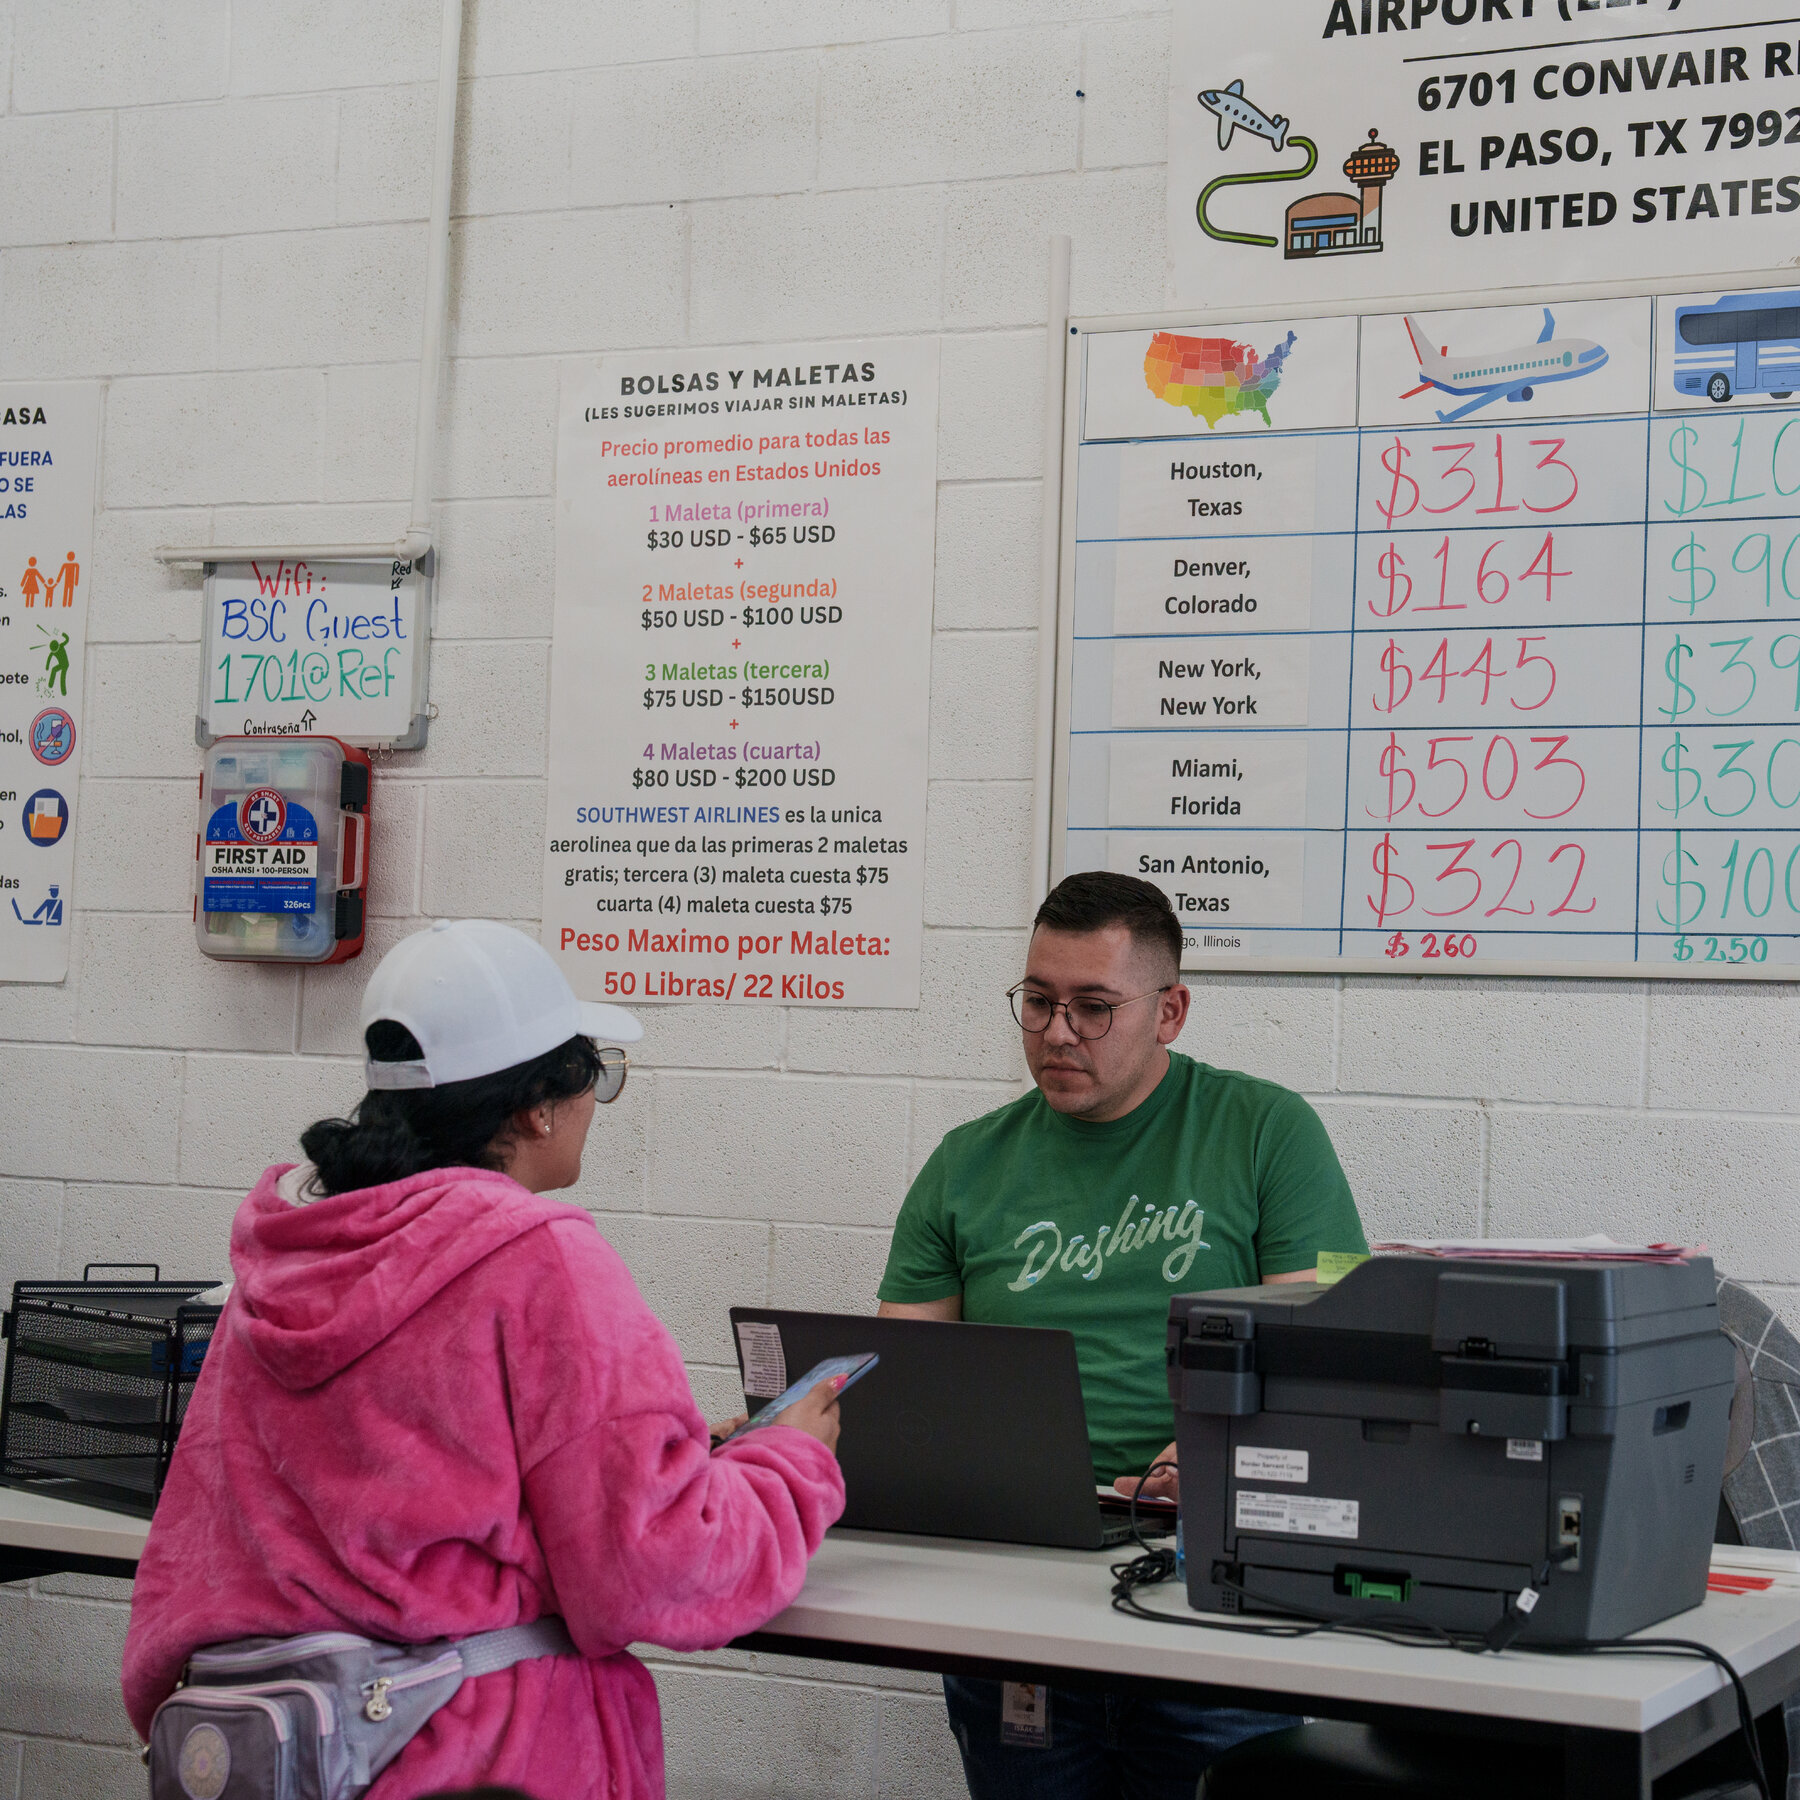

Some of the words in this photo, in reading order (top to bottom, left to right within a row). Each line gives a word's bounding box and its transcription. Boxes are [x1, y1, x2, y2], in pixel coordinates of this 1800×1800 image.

[1418, 69, 1515, 111] 6701
[1533, 47, 1749, 100] CONVAIR
[1765, 40, 1800, 78] R
[1419, 140, 1464, 176] EL
[1481, 127, 1612, 171] PASO,
[1628, 118, 1687, 157] TX
[1451, 192, 1617, 237] UNITED
[1633, 176, 1800, 223] STATES
[621, 372, 719, 395] BOLSAS
[728, 370, 744, 389] Y
[753, 362, 875, 388] MALETAS
[0, 407, 47, 425] ASA
[585, 407, 618, 422] (LES
[624, 402, 719, 418] SUGERIMOS
[725, 398, 783, 412] VIAJAR
[789, 396, 815, 409] SIN
[822, 390, 907, 407] MALETAS)
[602, 439, 658, 457] Precio
[664, 434, 753, 459] promedio
[759, 436, 800, 454] para
[805, 429, 858, 447] todas
[865, 427, 890, 444] las
[608, 468, 702, 487] aerolíneas
[708, 470, 729, 482] en
[736, 462, 808, 481] Estados
[815, 459, 880, 477] Unidos
[1171, 462, 1262, 480] Houston,
[1375, 434, 1579, 529] $313
[14, 477, 34, 492] SE
[650, 506, 659, 522] 1
[666, 503, 731, 521] Maleta
[738, 498, 828, 523] (primera)
[1188, 499, 1242, 516] Texas
[647, 529, 683, 551] $30
[691, 529, 731, 547] USD
[750, 525, 786, 547] $65
[794, 525, 835, 543] USD
[391, 559, 412, 576] Red
[1174, 560, 1250, 578] Denver,
[1368, 531, 1573, 618] $164
[251, 560, 327, 598] Wifi:
[643, 585, 652, 602] 2
[659, 583, 733, 601] Maletas
[740, 578, 837, 603] (segunda)
[1165, 594, 1257, 614] Colorado
[222, 599, 286, 642] BSC
[641, 609, 677, 631] $50
[684, 609, 724, 627] USD
[743, 606, 793, 628] $100
[801, 606, 842, 624] USD
[645, 664, 655, 681] 3
[663, 662, 737, 680] Maletas
[744, 659, 829, 681] (tercera)
[1159, 661, 1204, 678] New
[1211, 658, 1260, 680] York,
[1372, 636, 1557, 714] $445
[643, 688, 676, 710] $75
[683, 689, 723, 707] USD
[742, 686, 834, 708] $150USD
[1161, 698, 1206, 715] New
[1213, 695, 1257, 714] York
[243, 719, 300, 736] Contraseña
[643, 744, 654, 760] 4
[661, 742, 736, 760] Maletas
[743, 741, 820, 761] (cuarta)
[632, 768, 669, 789] $80
[676, 769, 716, 787] USD
[735, 767, 786, 789] $200
[793, 769, 835, 786] USD
[1172, 759, 1242, 781] Miami,
[1365, 732, 1586, 823] $503
[577, 807, 689, 823] SOUTHWEST
[694, 807, 779, 823] AIRLINES
[785, 810, 805, 823] es
[811, 806, 826, 823] la
[832, 806, 882, 823] unica
[1171, 796, 1240, 815] Florida
[215, 848, 268, 864] FIRST
[272, 848, 306, 864] AID
[550, 836, 631, 852] aerolinea
[637, 840, 669, 857] que
[675, 836, 696, 853] da
[702, 836, 726, 853] las
[732, 836, 813, 857] primeras
[818, 837, 828, 853] 2
[834, 836, 907, 853] maletas
[212, 866, 233, 874] OSHA
[235, 866, 255, 874] ANSI
[565, 865, 618, 886] gratis;
[623, 868, 688, 882] tercera
[694, 866, 716, 885] (3)
[723, 866, 785, 883] maleta
[790, 869, 851, 883] cuesta
[856, 865, 888, 886] $75
[1139, 855, 1174, 873] San
[1181, 855, 1269, 878] Antonio,
[1366, 832, 1598, 928] $322
[597, 897, 653, 912] cuarta
[658, 895, 681, 914] (4)
[688, 896, 749, 913] maleta
[755, 899, 815, 914] cuesta
[820, 895, 852, 916] $75
[1175, 893, 1229, 912] Texas
[561, 928, 619, 951] Peso
[628, 928, 729, 953] Maximo
[738, 936, 783, 960] por
[791, 930, 890, 955] Maleta:
[1203, 935, 1241, 948] Illinois
[605, 972, 636, 995] 50
[645, 971, 737, 1000] Libras/
[744, 974, 773, 998] 22
[782, 974, 844, 999] Kilos
[1007, 1194, 1211, 1292] Dashing
